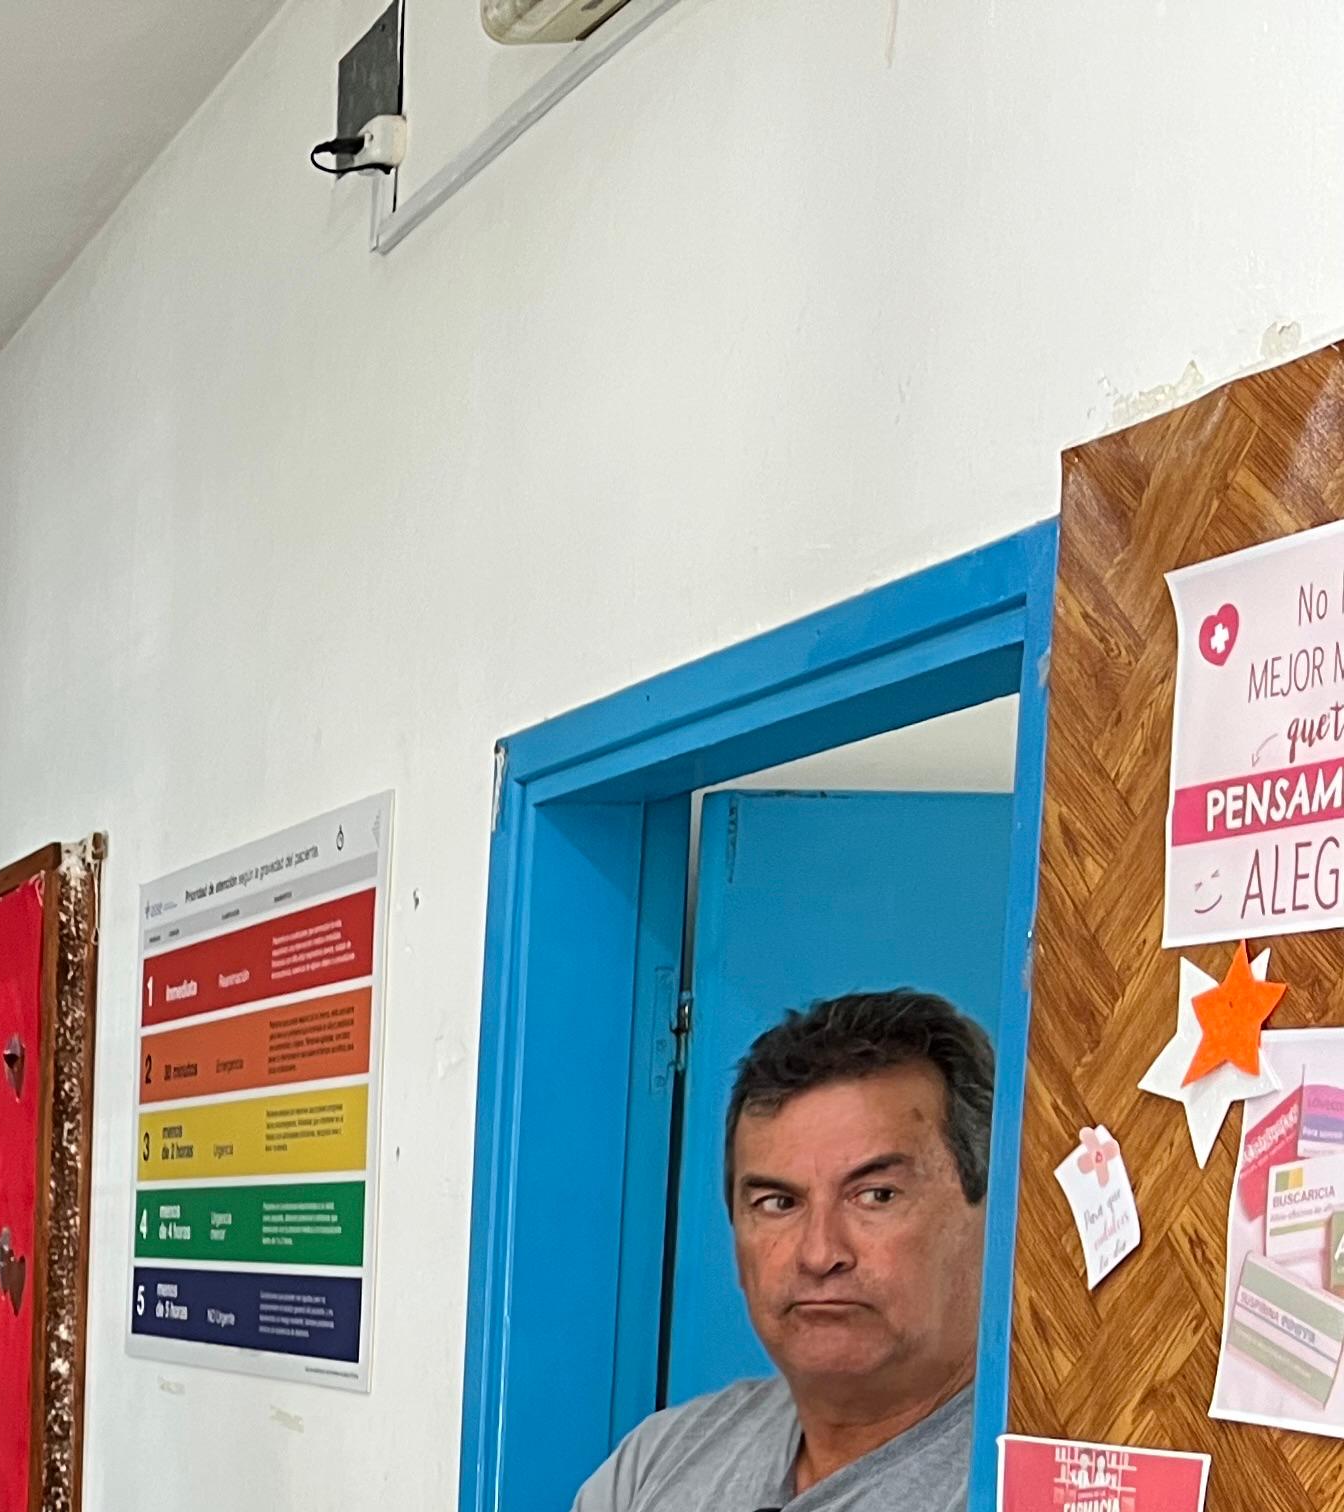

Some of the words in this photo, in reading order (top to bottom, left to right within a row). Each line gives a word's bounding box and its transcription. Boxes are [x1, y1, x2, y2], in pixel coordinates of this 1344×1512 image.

[1298, 582, 1328, 626] No
[1248, 642, 1324, 704] MEJOR
[1206, 766, 1343, 832] PENSAM
[1240, 836, 1340, 919] ALEG
[147, 975, 153, 1007] 1
[145, 1054, 152, 1084] 2
[143, 1131, 150, 1161] 3
[139, 1208, 148, 1240] 4
[136, 1285, 145, 1316] 5
